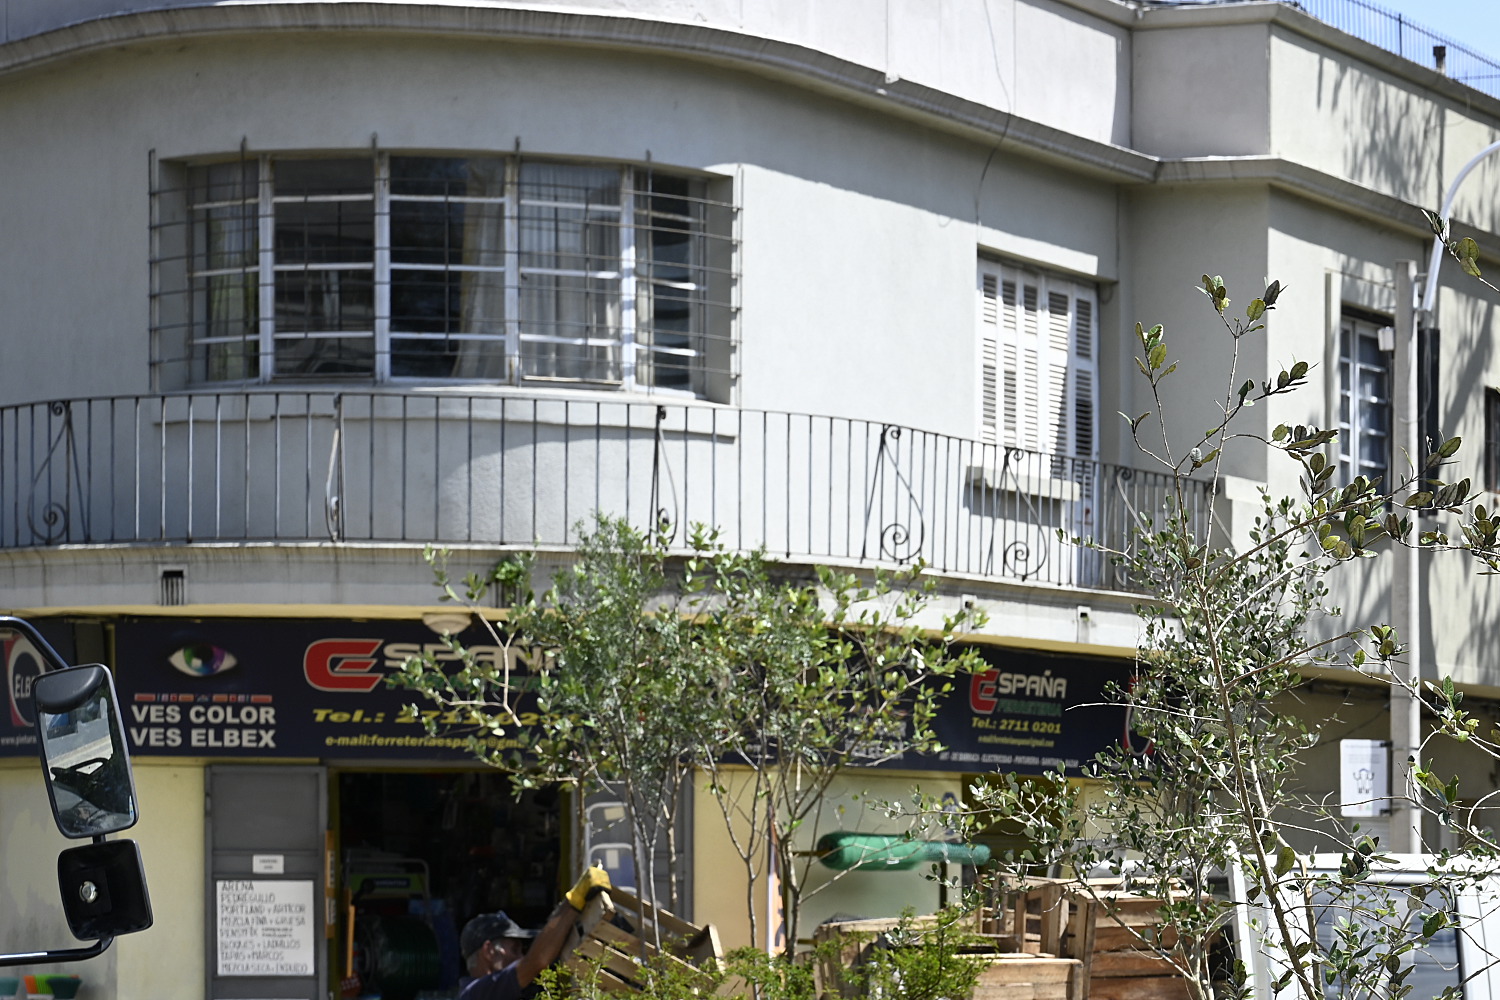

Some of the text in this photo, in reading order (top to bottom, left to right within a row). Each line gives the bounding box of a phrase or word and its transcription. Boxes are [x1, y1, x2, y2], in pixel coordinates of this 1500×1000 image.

[970, 669, 1066, 714] ESPAÑA
[131, 705, 276, 724] VES COLOR
[313, 708, 385, 723] Tel.:
[972, 717, 1061, 734] Tel.: 2711 0201
[130, 728, 276, 748] VES ELBEX
[222, 880, 254, 891] ARENA
